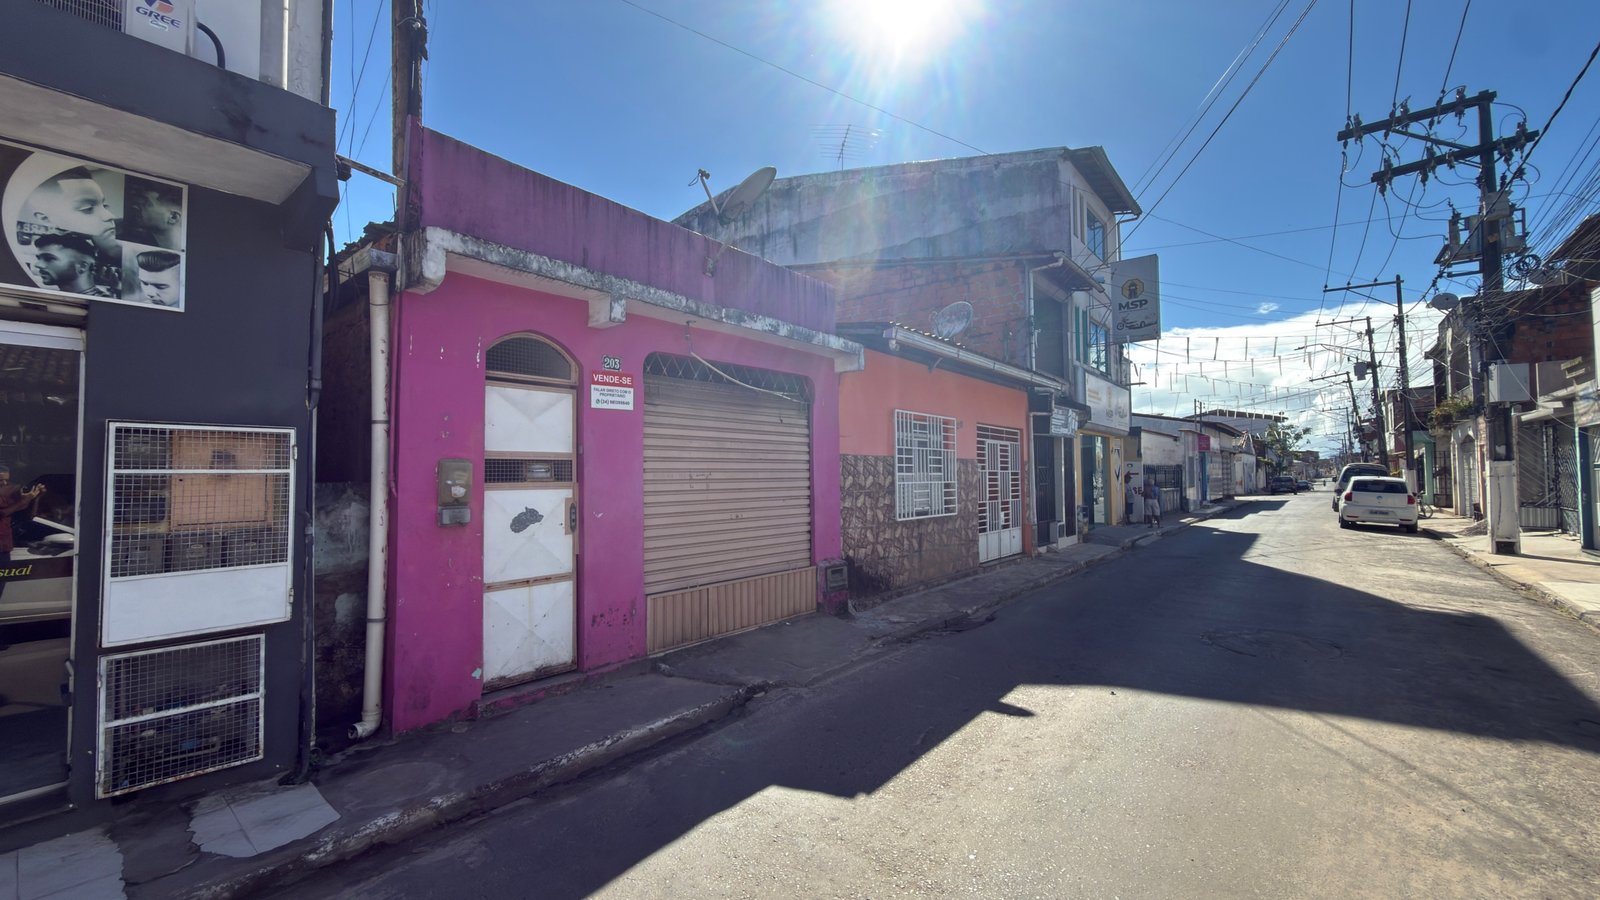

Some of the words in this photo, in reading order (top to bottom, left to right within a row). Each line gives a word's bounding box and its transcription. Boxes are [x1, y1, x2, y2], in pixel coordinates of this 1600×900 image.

[136, 6, 181, 28] GREE
[1118, 299, 1148, 311] MSP
[604, 357, 620, 369] 203
[593, 374, 632, 385] VENDE-SE
